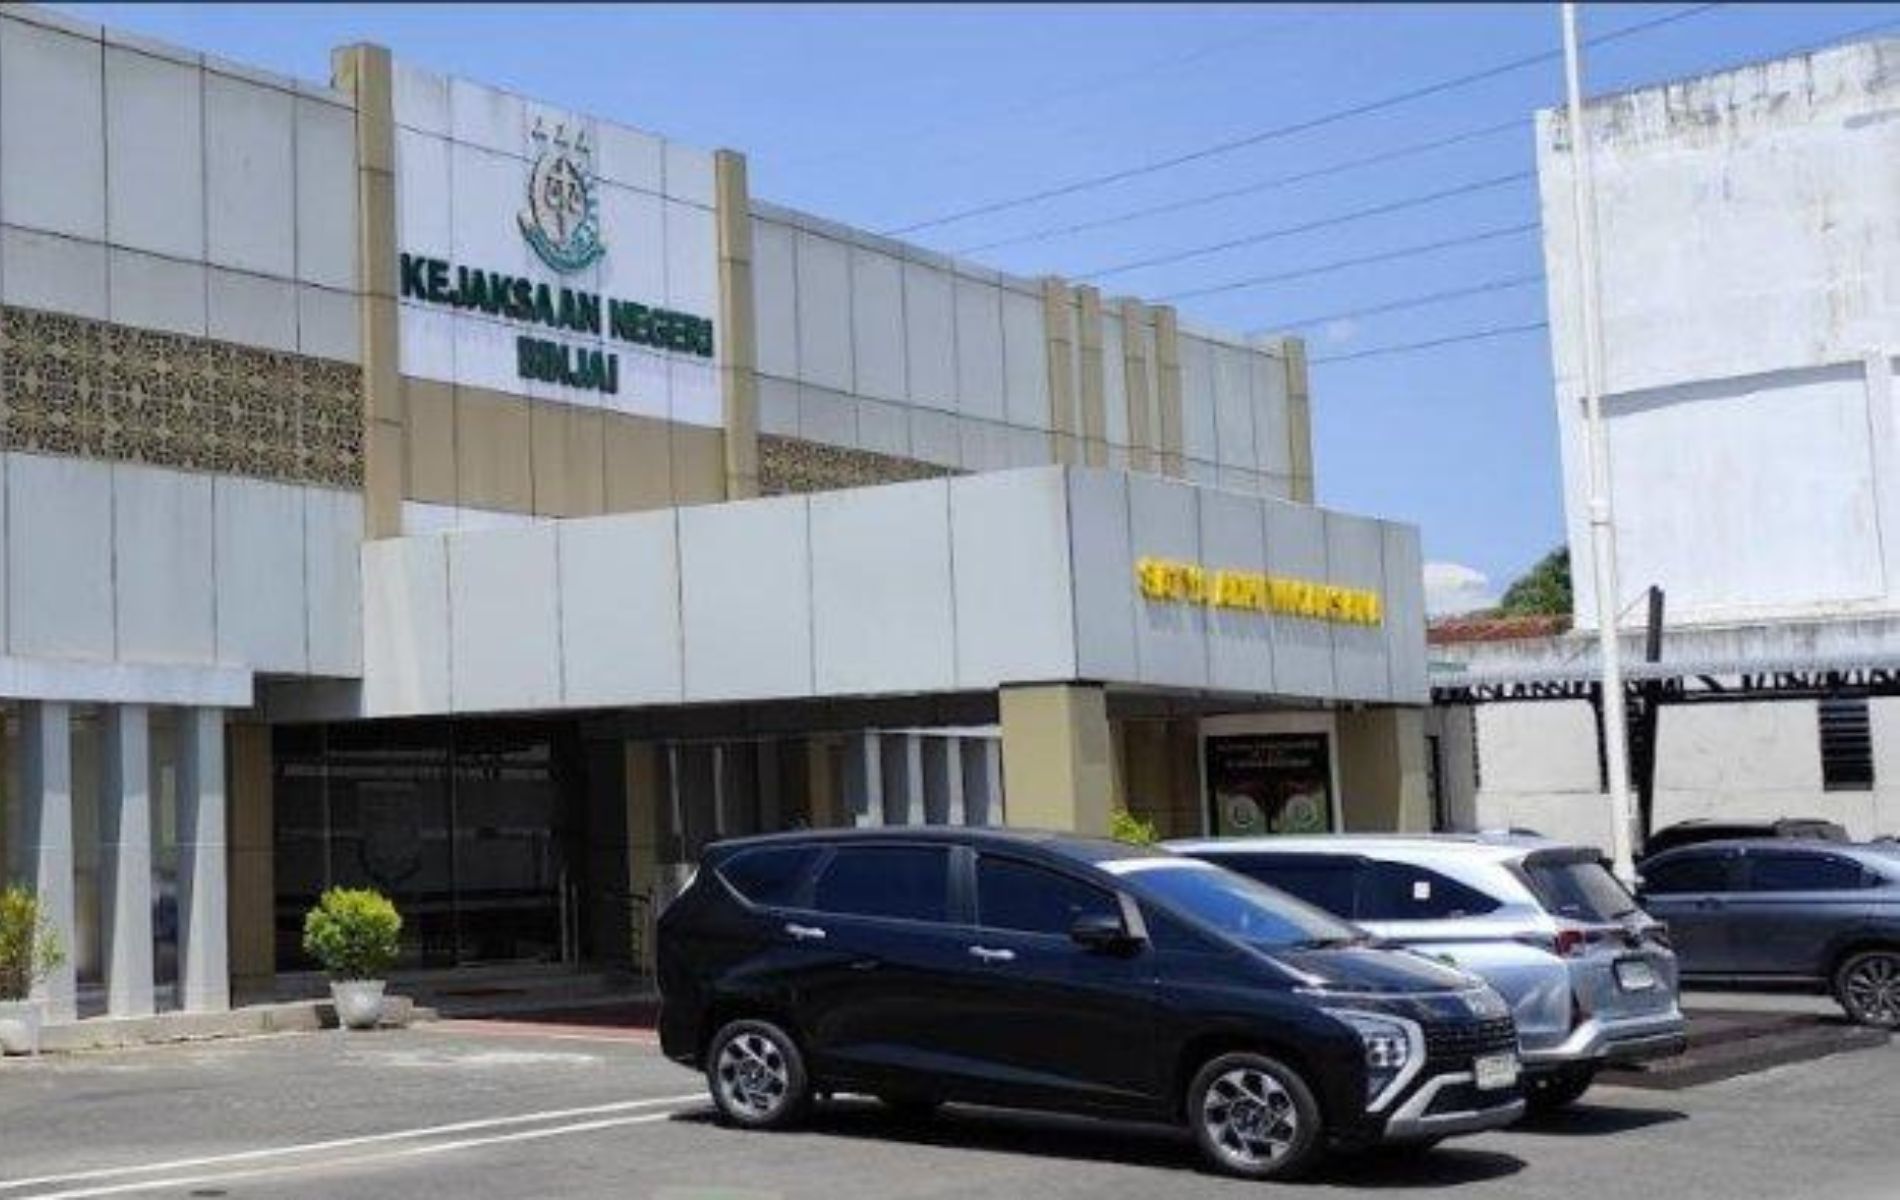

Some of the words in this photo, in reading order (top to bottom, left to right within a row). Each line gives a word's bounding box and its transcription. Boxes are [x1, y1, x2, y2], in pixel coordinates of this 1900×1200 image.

[400, 253, 600, 336] KEJAKSAAN
[608, 298, 714, 357] NEGERI
[516, 336, 618, 394] BINJAI
